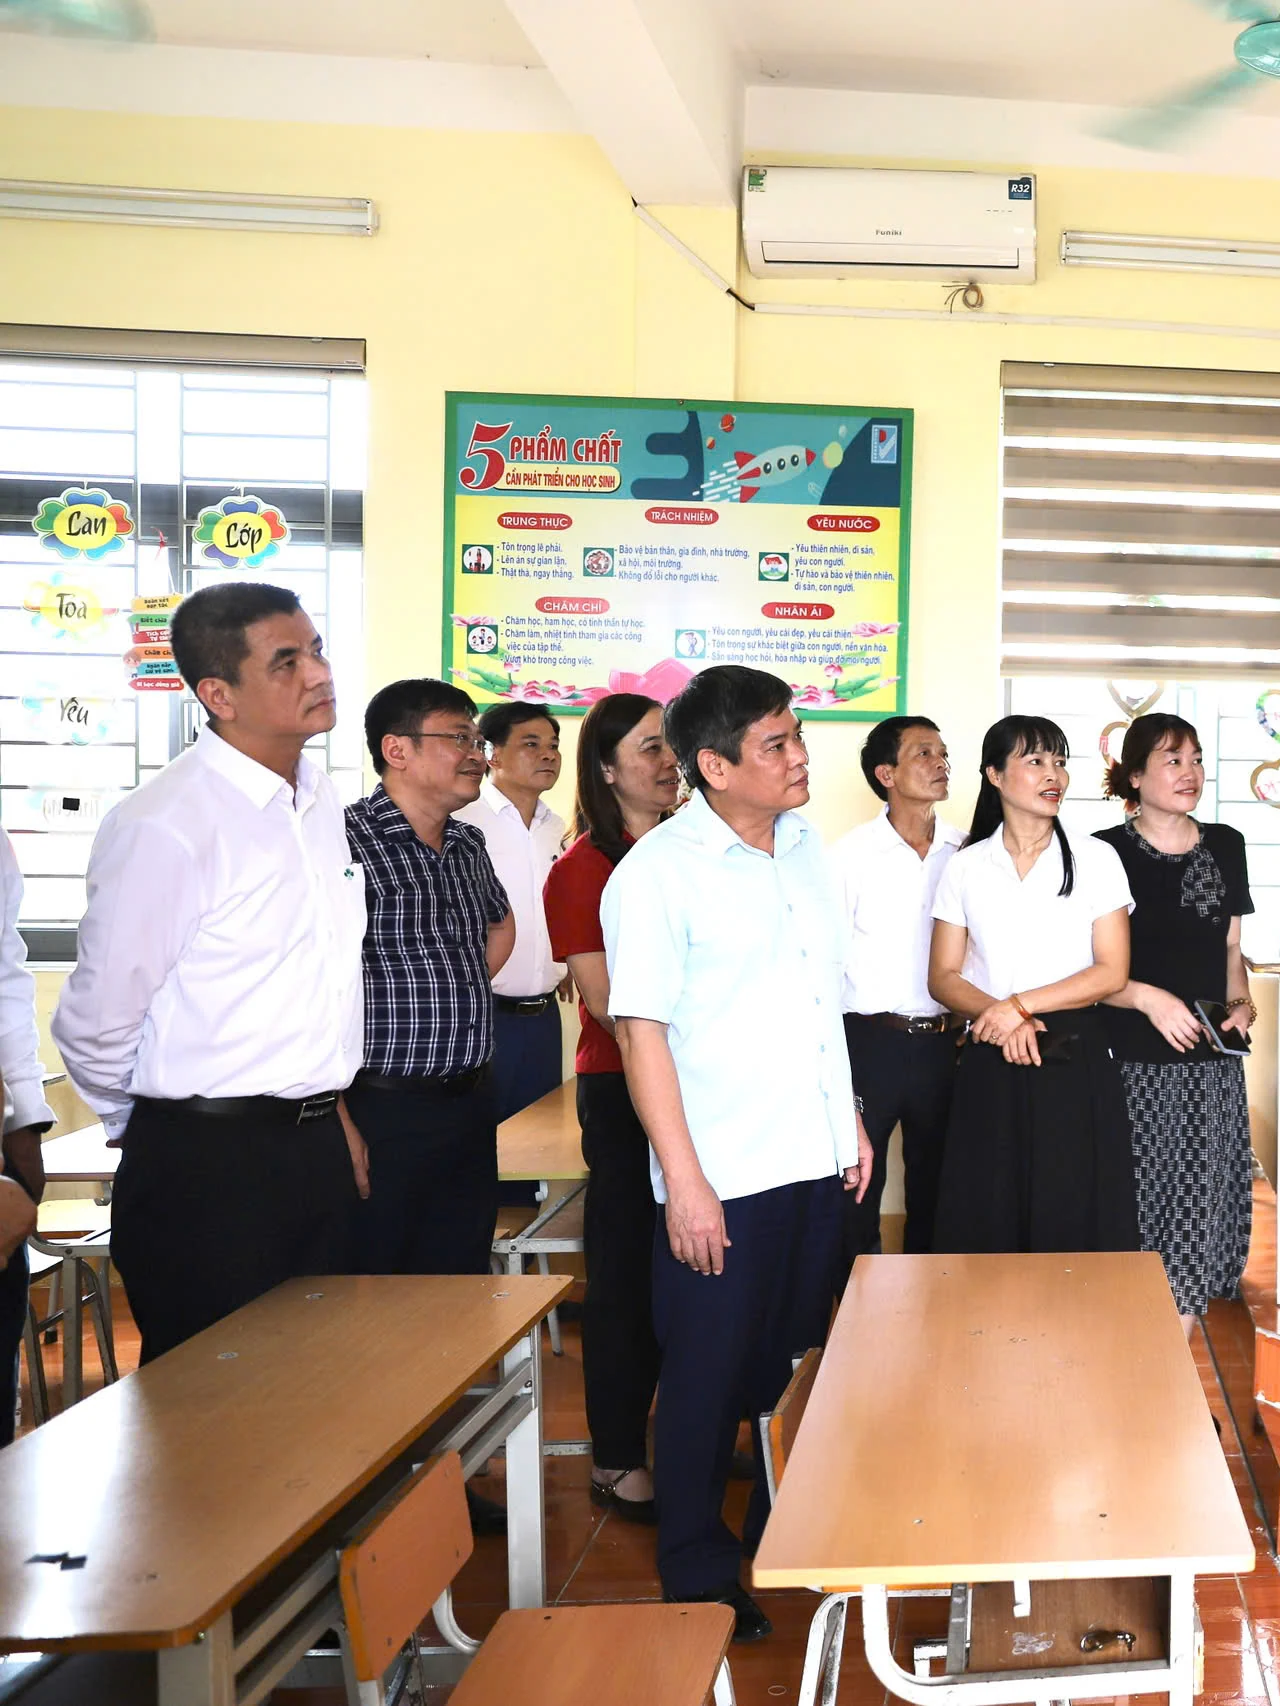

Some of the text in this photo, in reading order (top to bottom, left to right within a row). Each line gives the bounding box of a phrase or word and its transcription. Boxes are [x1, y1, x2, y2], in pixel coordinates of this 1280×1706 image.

[1011, 184, 1030, 193] R32
[459, 420, 623, 492] 5 PHẨM CHẤT
[506, 467, 615, 491] CẦN PHÁT TRIỂN CHO HỌC SINH
[651, 509, 713, 523] TRÁCH NHIỆM
[66, 510, 107, 537] Lan
[502, 516, 568, 528] TRUNG THỰC
[816, 517, 872, 529] YÊU NƯỚC
[225, 522, 263, 553] Lớp
[501, 542, 515, 551] Tôn
[516, 543, 535, 553] trọng
[619, 545, 633, 554] Bảo
[635, 546, 643, 556] vệ
[679, 547, 689, 557] gia
[710, 548, 723, 557] nhà
[795, 543, 808, 553] Yêu
[810, 544, 827, 553] thiên
[853, 545, 860, 553] di
[501, 555, 514, 564] Lên
[537, 557, 552, 566] gian
[795, 556, 807, 567] yêu
[501, 568, 517, 579] Thật
[533, 571, 551, 579] ngay
[665, 572, 678, 580] cho
[795, 569, 805, 580] Tự
[830, 570, 843, 579] bảo
[845, 571, 853, 581] vệ
[855, 571, 872, 580] thiên
[543, 600, 579, 611] CHĂM
[775, 605, 822, 616] NHÂN ÁI
[505, 616, 526, 625] Chăm
[545, 617, 560, 625] ham
[505, 628, 526, 637] Chăm
[578, 631, 596, 639] tham
[598, 631, 609, 642] gia
[727, 628, 740, 636] con
[765, 627, 778, 638] yêu
[808, 629, 821, 639] yêu
[522, 641, 536, 650] của
[538, 656, 557, 666] trong
[558, 656, 576, 667] công
[808, 654, 817, 663] và
[60, 696, 89, 726] Yêu
